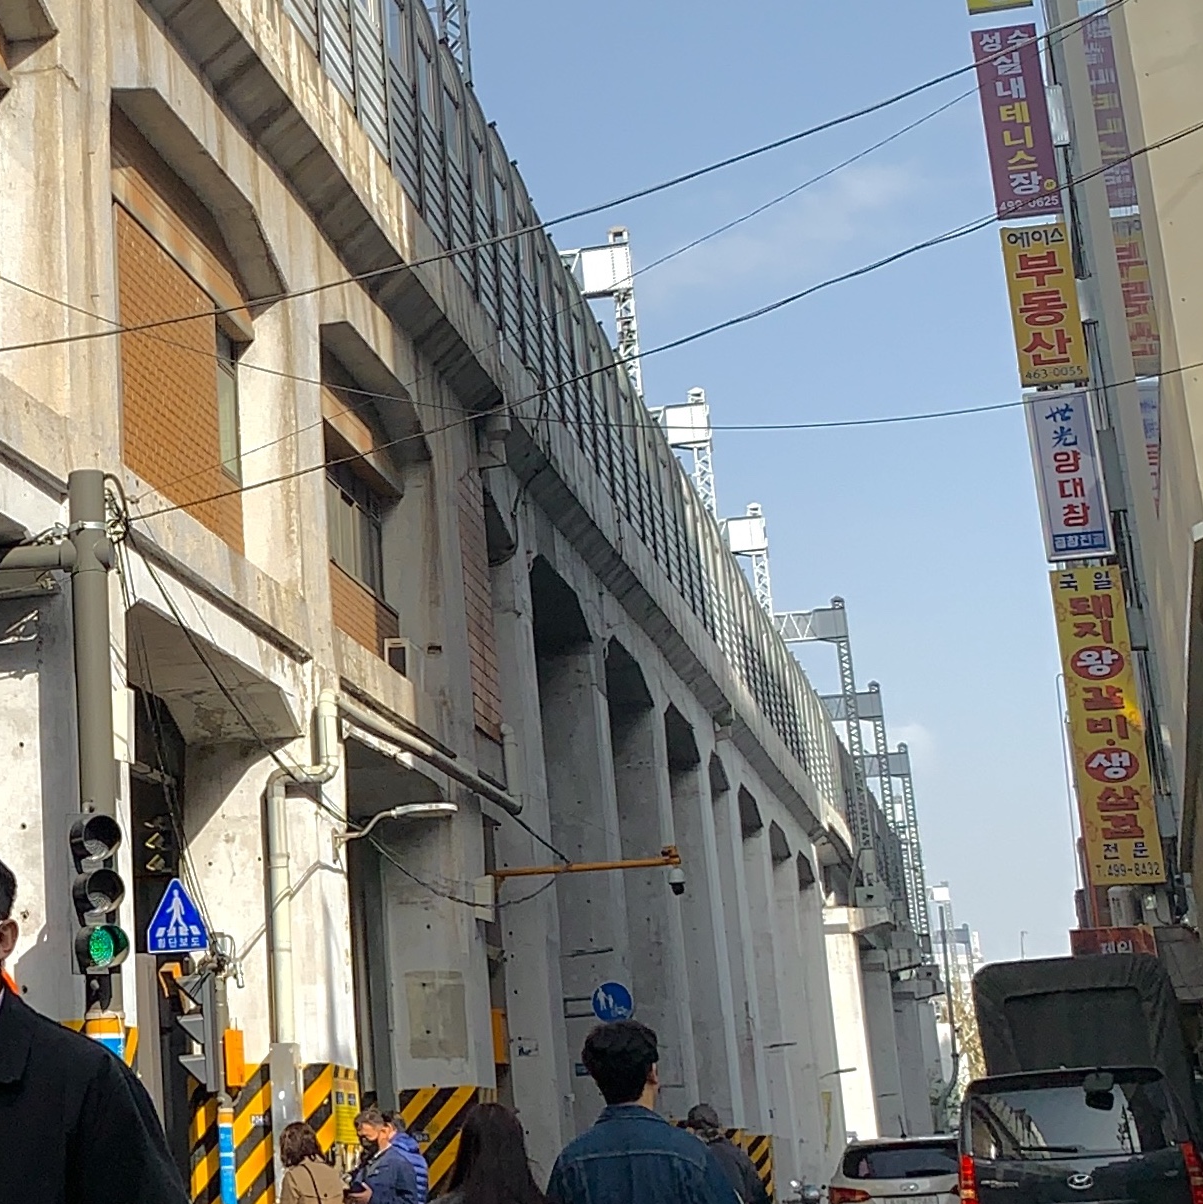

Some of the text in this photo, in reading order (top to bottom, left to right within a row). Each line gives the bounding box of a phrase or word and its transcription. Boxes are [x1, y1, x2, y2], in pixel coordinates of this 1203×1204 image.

[1007, 228, 1065, 248] 에이스
[1014, 250, 1073, 367] 부동산
[1025, 366, 1084, 380] 463-0055
[1053, 450, 1091, 527] 양대창
